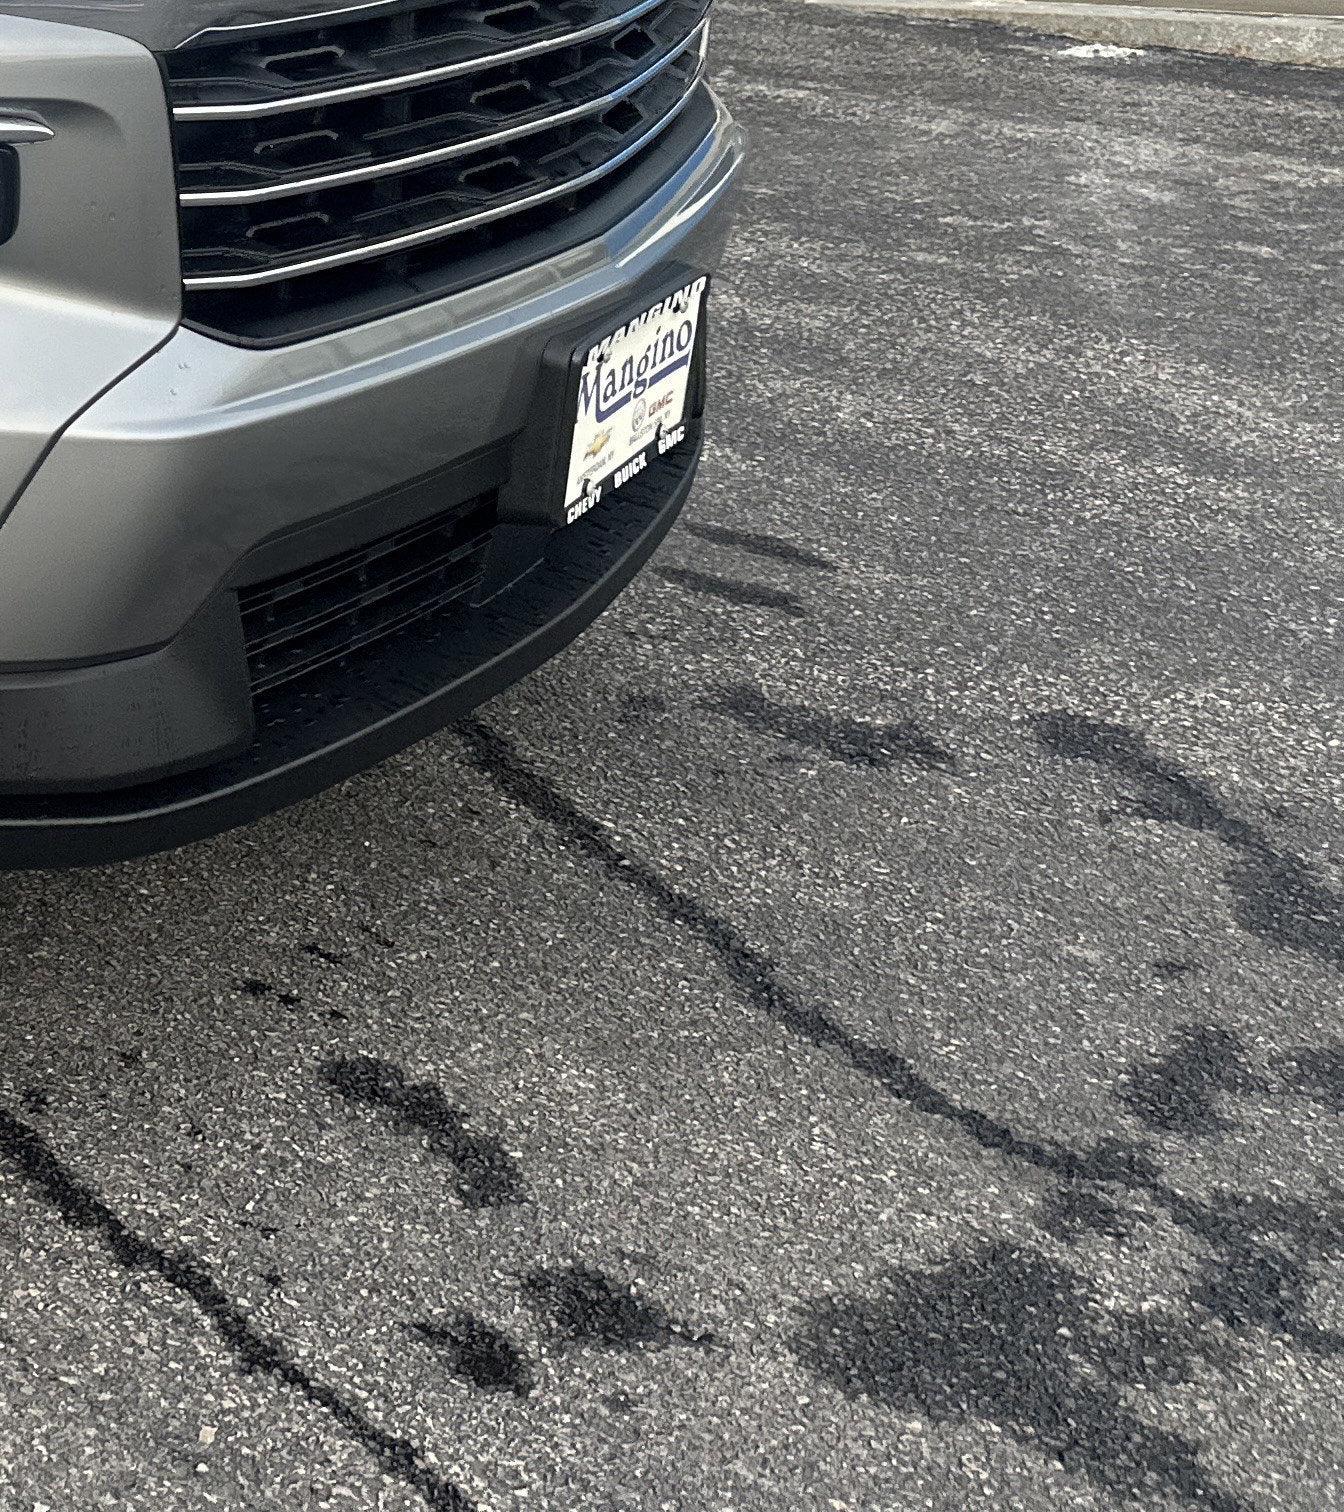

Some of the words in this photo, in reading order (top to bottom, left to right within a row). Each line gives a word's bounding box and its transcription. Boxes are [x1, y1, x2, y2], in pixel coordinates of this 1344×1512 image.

[578, 319, 693, 420] Mangino
[566, 485, 602, 525] CHEVY
[613, 451, 648, 489] BUICK
[657, 425, 686, 455] GMC
